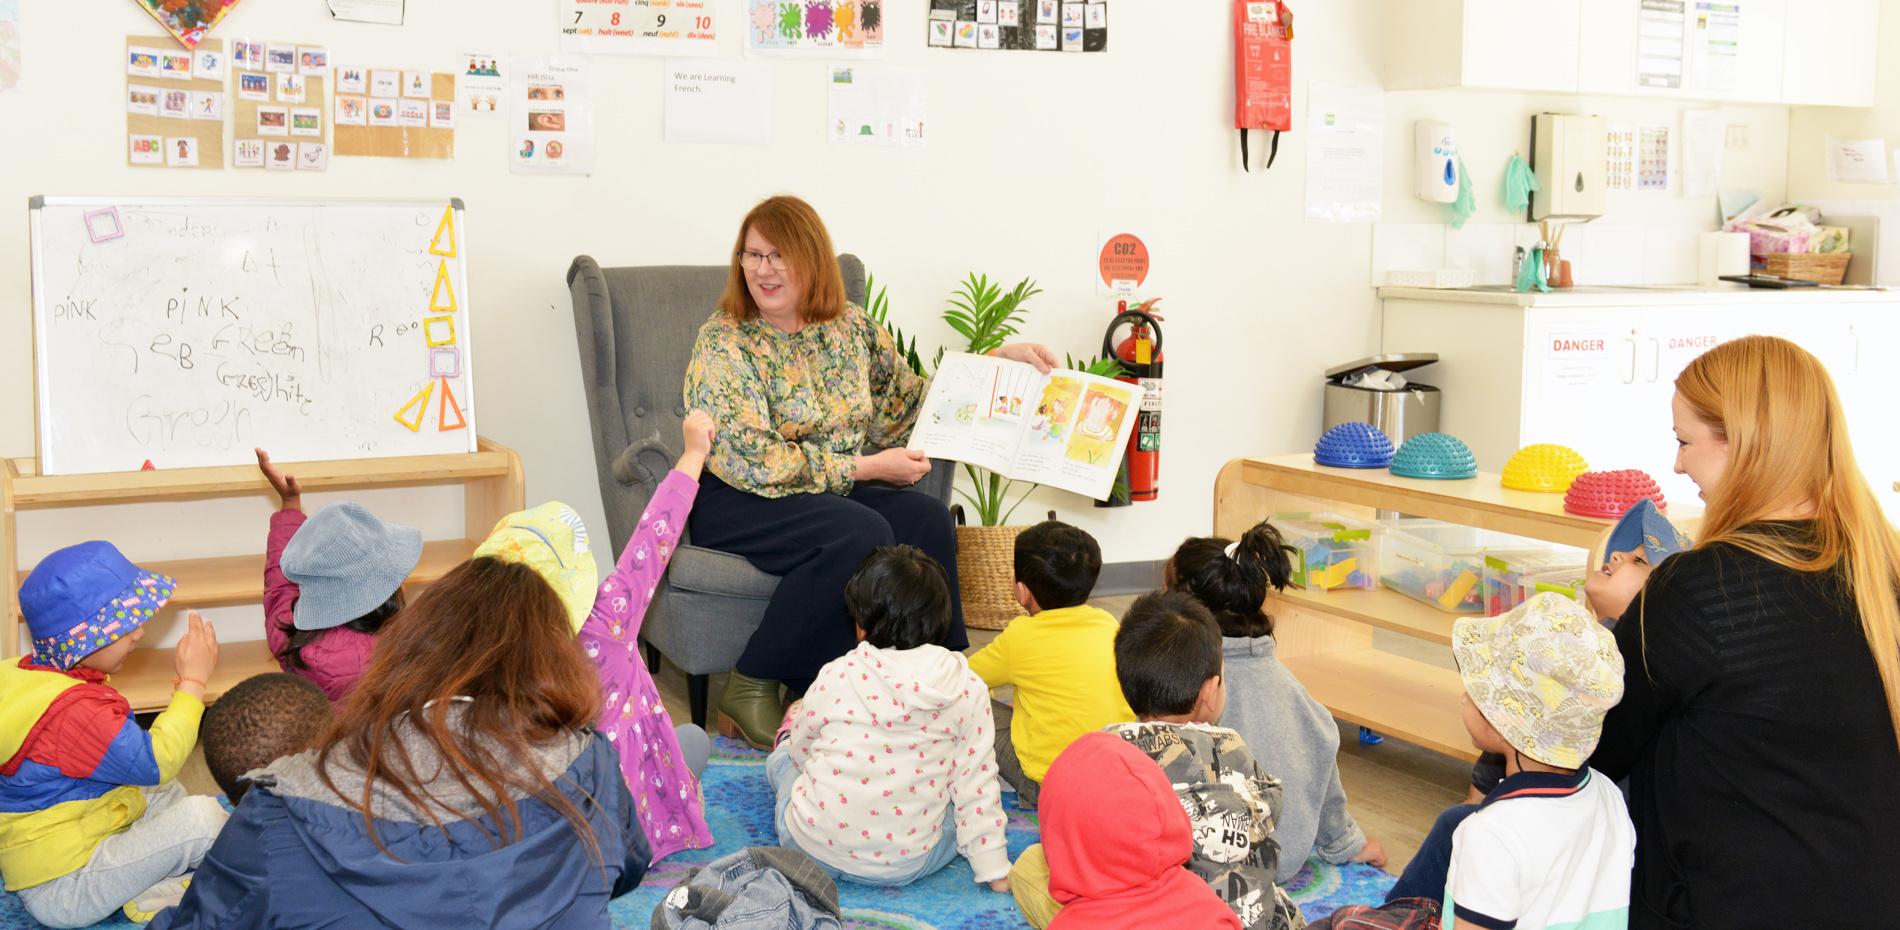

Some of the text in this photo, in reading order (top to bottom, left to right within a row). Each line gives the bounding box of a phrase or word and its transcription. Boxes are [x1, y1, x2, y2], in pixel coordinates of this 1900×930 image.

[686, 1, 704, 9] (sees)
[575, 11, 583, 24] 7
[611, 12, 621, 26] 8
[657, 14, 666, 28] 9
[695, 16, 711, 30] 10
[578, 27, 593, 36] (set)
[598, 28, 634, 37] huit (weet)
[1243, 22, 1258, 36] FIRE
[697, 32, 716, 40] (dees)
[674, 72, 688, 80] We
[704, 73, 736, 84] Learning
[674, 84, 703, 93] French.
[134, 139, 160, 152] ABC
[1114, 242, 1137, 255] CO2
[1554, 339, 1604, 352] DANGER
[1669, 336, 1718, 349] DANGER
[122, 596, 141, 608] MARVEL
[102, 620, 122, 635] MARVEL
